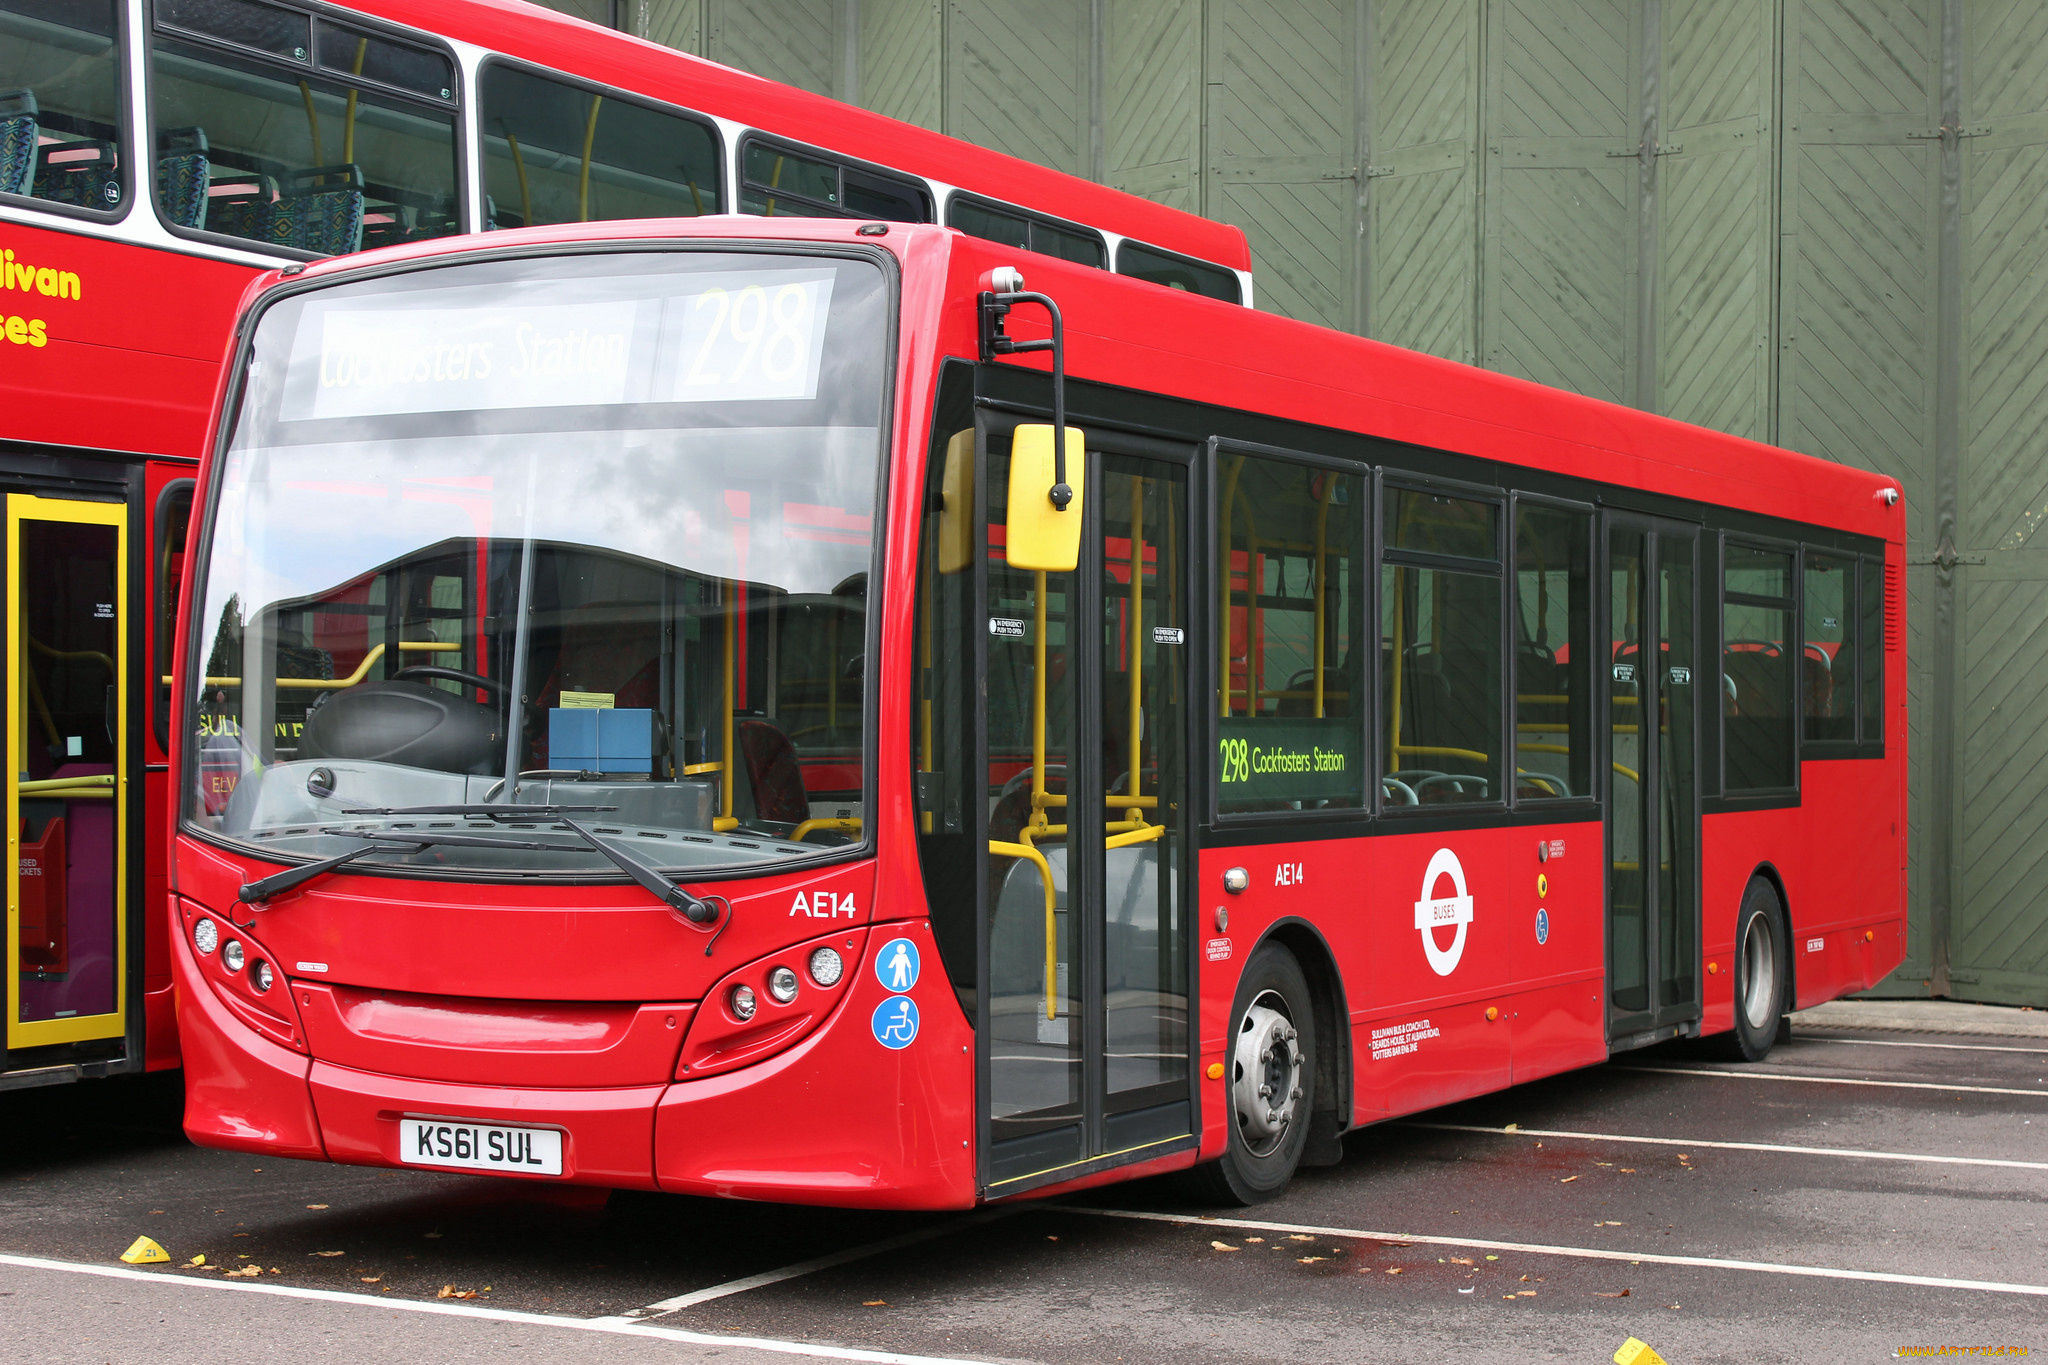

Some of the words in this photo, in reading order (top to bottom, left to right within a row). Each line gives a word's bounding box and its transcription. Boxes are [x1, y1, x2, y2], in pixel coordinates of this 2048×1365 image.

[0, 313, 48, 347] es
[684, 283, 809, 387] 298
[509, 322, 625, 378] Station
[1002, 620, 1022, 628] EMERGENCY
[1219, 738, 1249, 783] 298
[1252, 746, 1311, 774] Cockfosters
[1313, 745, 1345, 772] Station
[19, 868, 42, 876] CKETS
[1274, 862, 1304, 887] AE14
[789, 890, 856, 919] AE14
[1433, 904, 1455, 920] BUSES
[1371, 1026, 1394, 1040] SULLIVAN
[1393, 1025, 1402, 1036] BUS
[1405, 1020, 1421, 1033] COACH
[1372, 1038, 1390, 1051] DEARDS
[1406, 1032, 1412, 1043] ST
[1411, 1029, 1427, 1042] ALBANS
[1372, 1047, 1392, 1061] POTTERS
[417, 1125, 480, 1161] KS61
[488, 1131, 543, 1165] SUL
